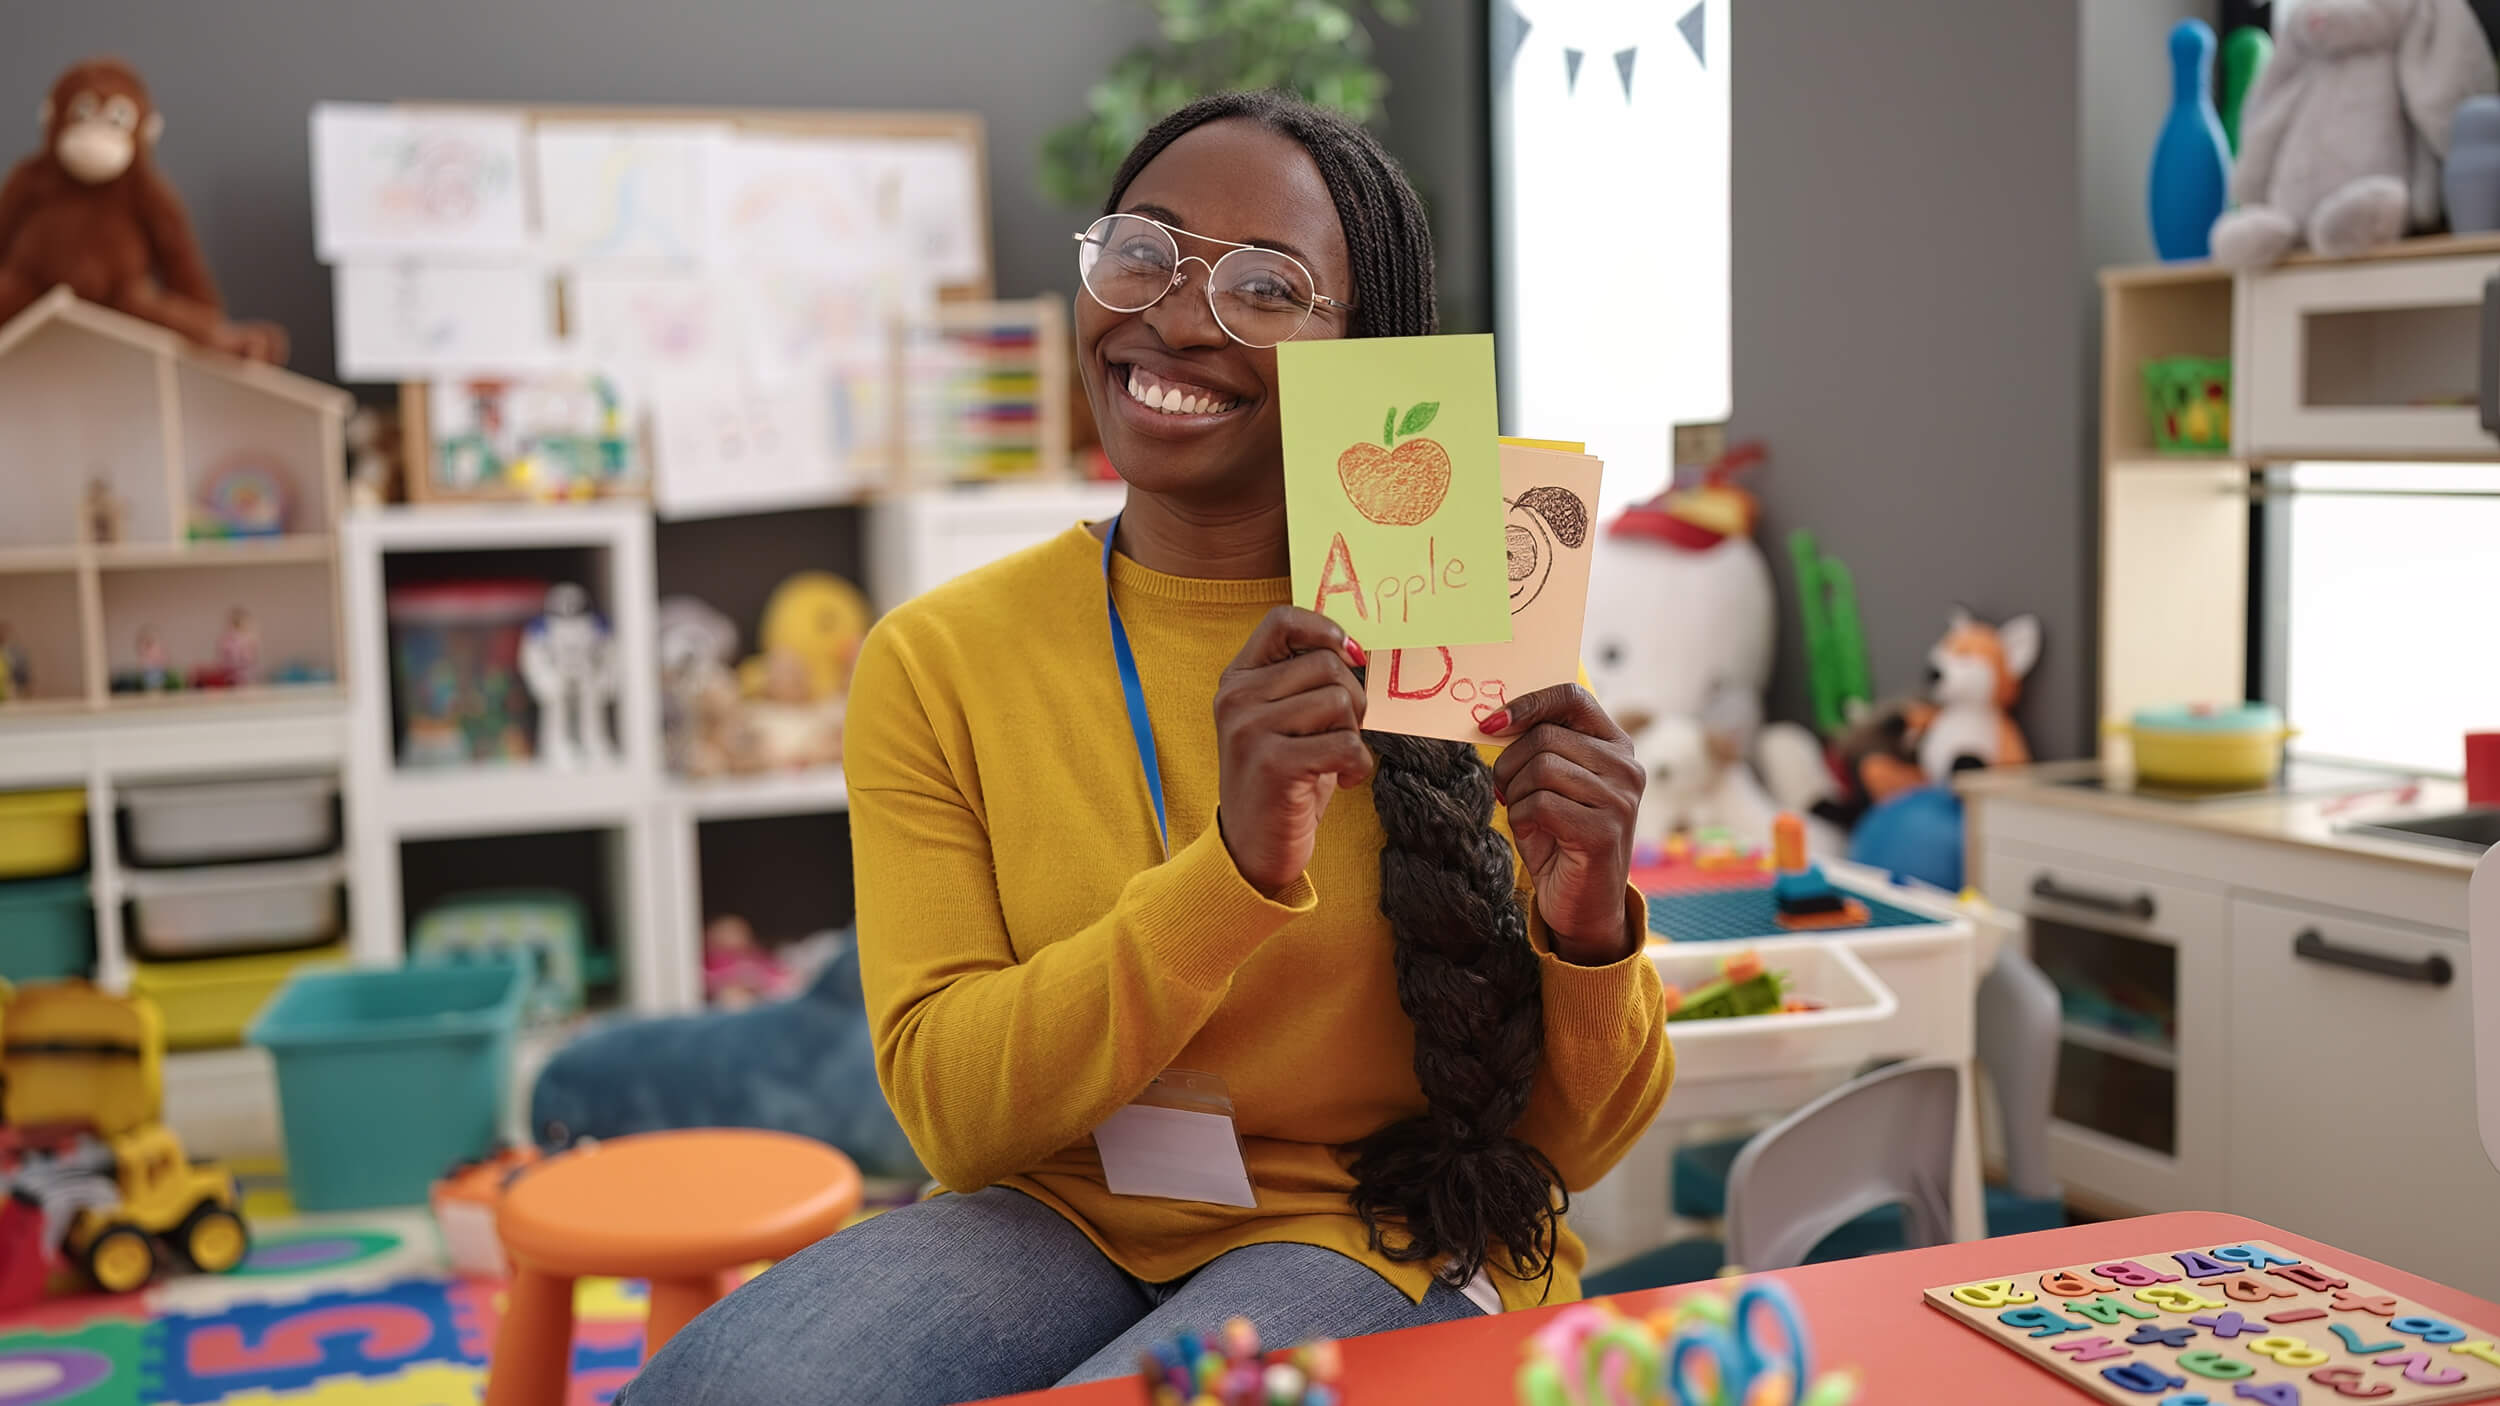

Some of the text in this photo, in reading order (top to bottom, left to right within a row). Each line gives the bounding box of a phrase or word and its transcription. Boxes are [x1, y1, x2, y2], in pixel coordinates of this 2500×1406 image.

[1314, 531, 1468, 624] Apple
[1388, 646, 1507, 726] Dog
[2246, 1336, 2330, 1367] 8
[2373, 1352, 2467, 1385] 2
